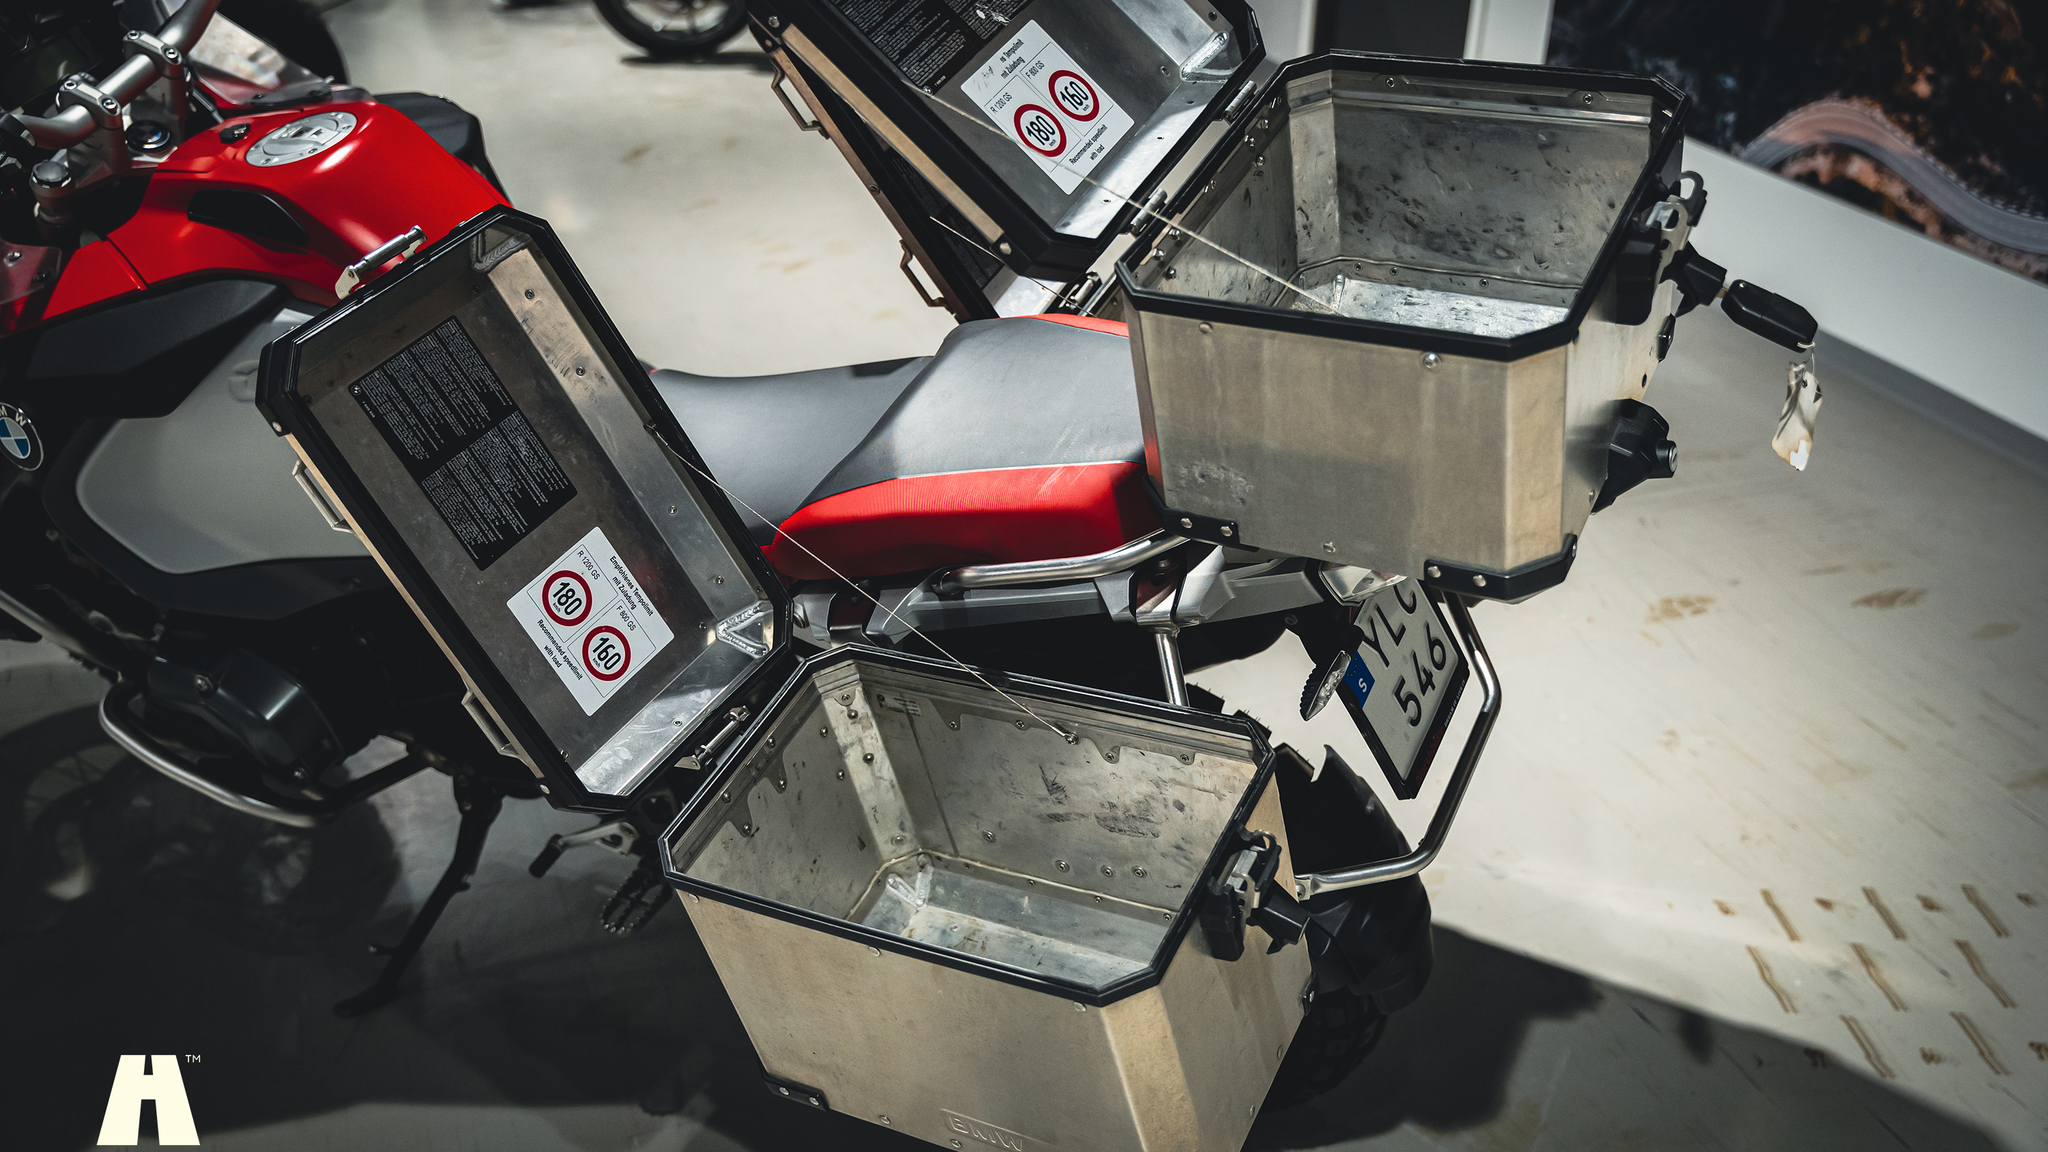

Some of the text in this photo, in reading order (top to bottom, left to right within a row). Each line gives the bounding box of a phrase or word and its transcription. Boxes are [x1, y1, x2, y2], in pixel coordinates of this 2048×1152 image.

[1000, 70, 1008, 78] mit
[1005, 55, 1025, 74] Zuladung
[1028, 65, 1038, 75] 800
[1035, 60, 1044, 69] GS
[994, 97, 1006, 110] 1200
[1002, 92, 1012, 101] GS
[1060, 81, 1089, 110] 160
[1025, 115, 1056, 146] 180
[1069, 123, 1107, 164] Recommended speedlimit
[1089, 144, 1104, 159] with load
[581, 556, 593, 570] 1200
[591, 569, 600, 580] GS
[553, 582, 583, 616] 180
[609, 556, 653, 616] Empfohlenes Tempolimit
[612, 576, 637, 609] mit Zuladung
[619, 610, 629, 621] 800
[627, 621, 636, 631] GS
[537, 619, 582, 680] Recommended speedlimit
[544, 645, 562, 667] with load
[592, 637, 622, 671] 160
[1358, 678, 1367, 692] S
[1393, 621, 1446, 727] 546
[948, 1115, 1022, 1152] BMW
